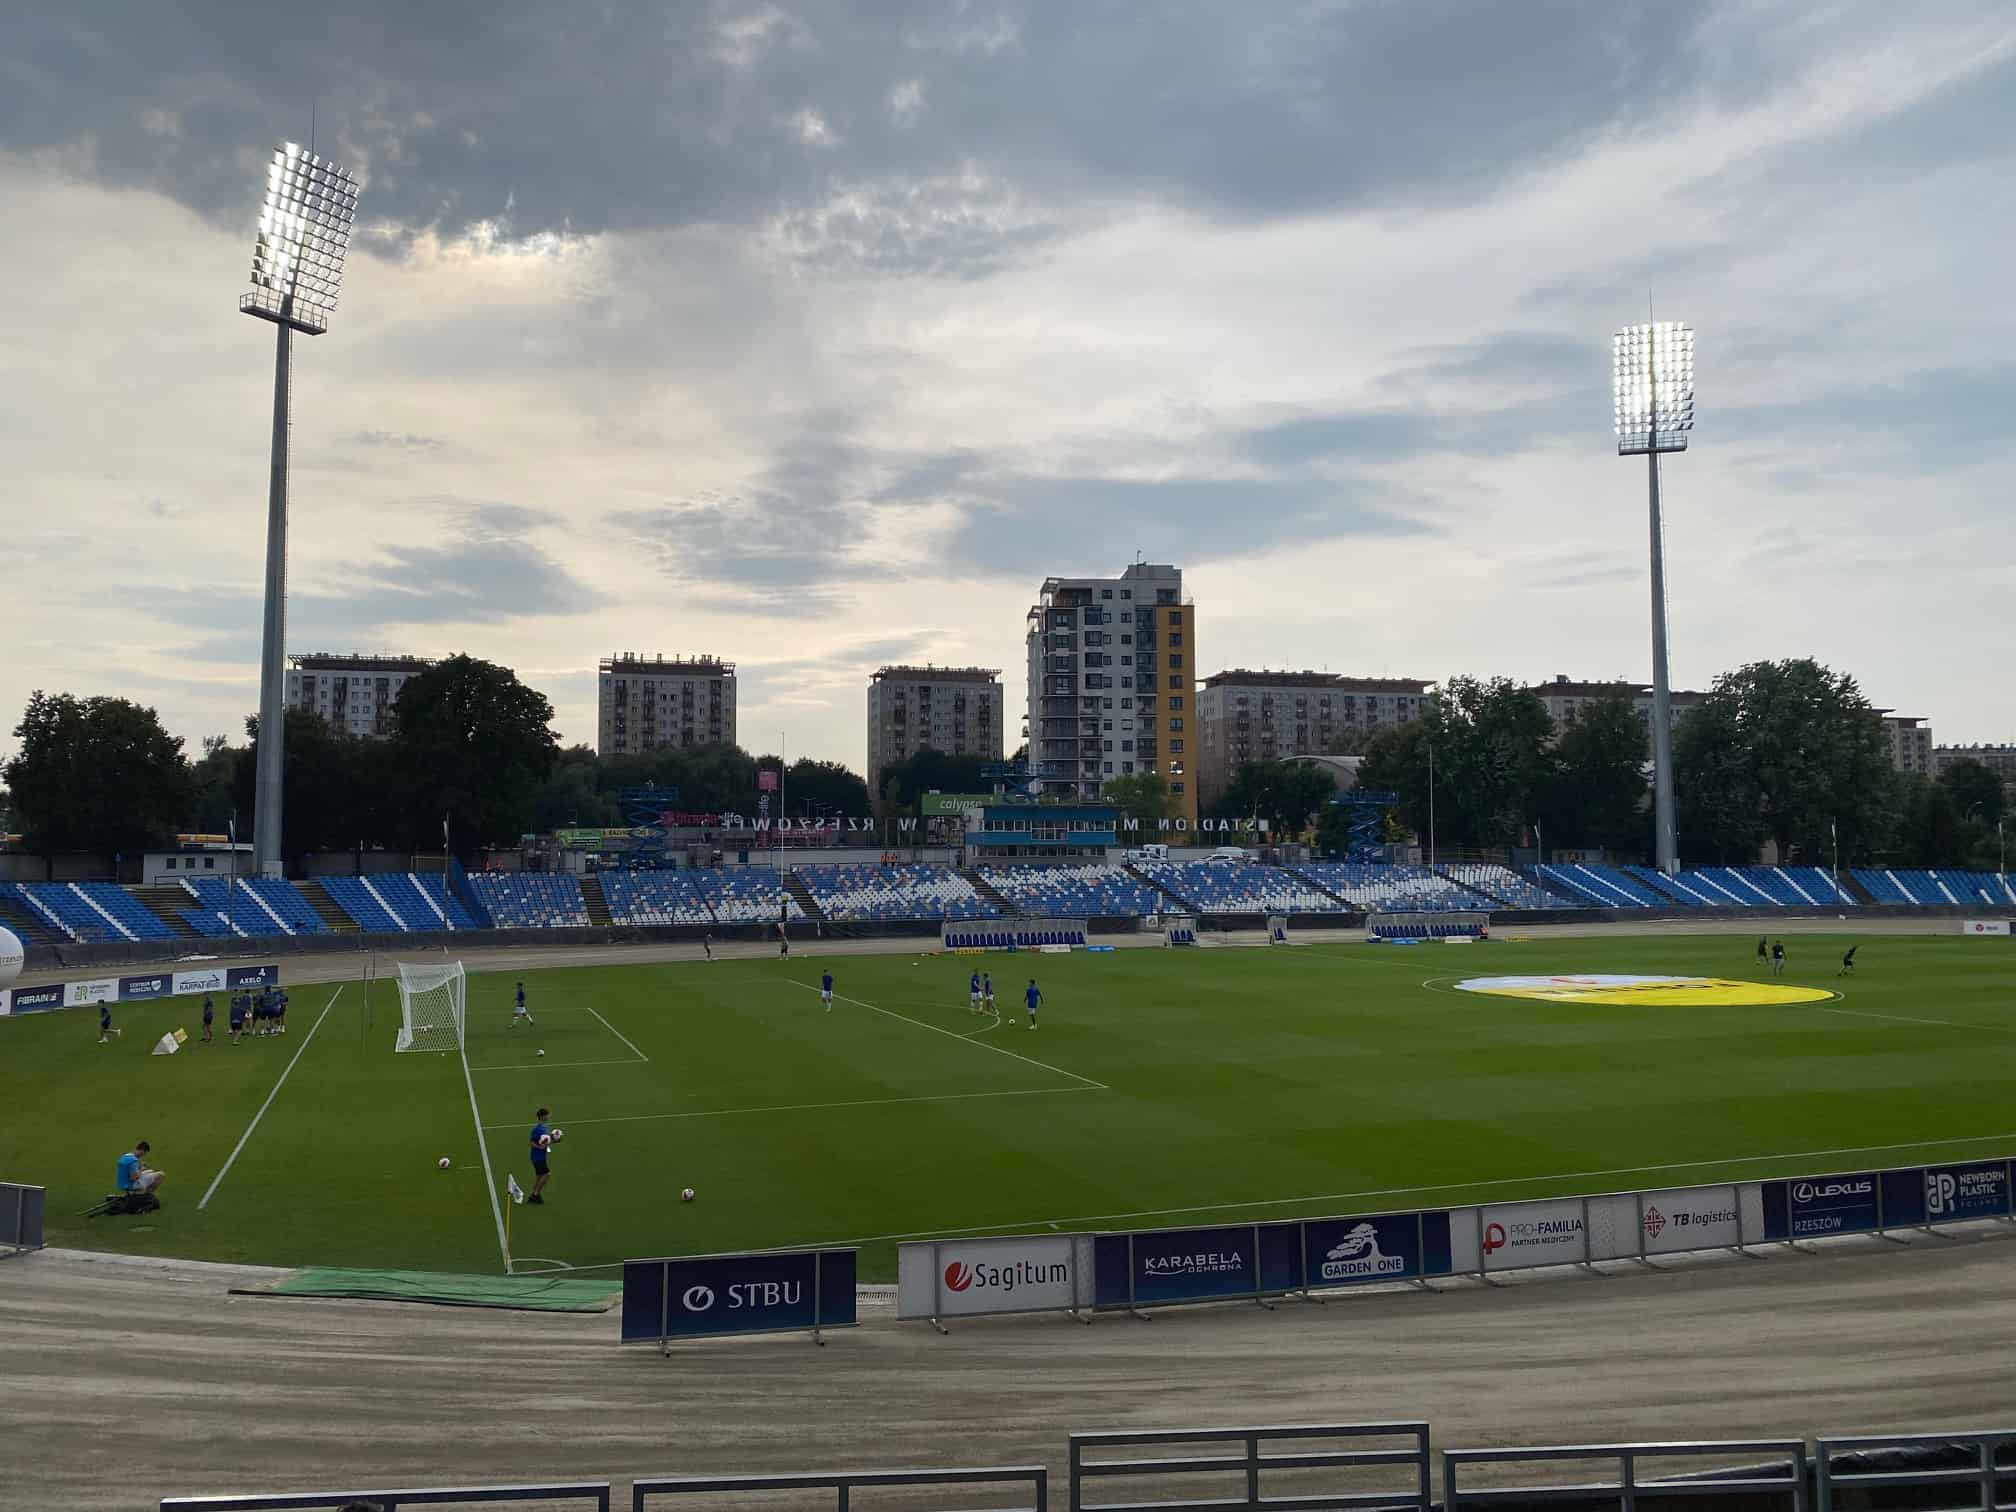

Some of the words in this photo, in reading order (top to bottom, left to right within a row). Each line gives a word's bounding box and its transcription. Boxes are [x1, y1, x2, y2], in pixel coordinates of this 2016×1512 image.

[1959, 1171, 2005, 1184] NEWBORN
[1815, 1182, 1872, 1197] LEXUS
[1959, 1183, 1997, 1196] PLASTIC
[1672, 1213, 1690, 1226] TB
[1692, 1209, 1737, 1226] logistics
[1795, 1216, 1842, 1231] RZESZÓW
[1511, 1219, 1584, 1236] PRO-FAMILIA
[1511, 1237, 1540, 1247] PARTNER
[1144, 1251, 1242, 1271] KARABELA
[1188, 1263, 1242, 1273] OCHRONA
[1324, 1261, 1372, 1278] GARDEN
[1377, 1258, 1402, 1273] ONE
[974, 1261, 1067, 1291] Sagitum
[728, 1280, 801, 1309] STBU
